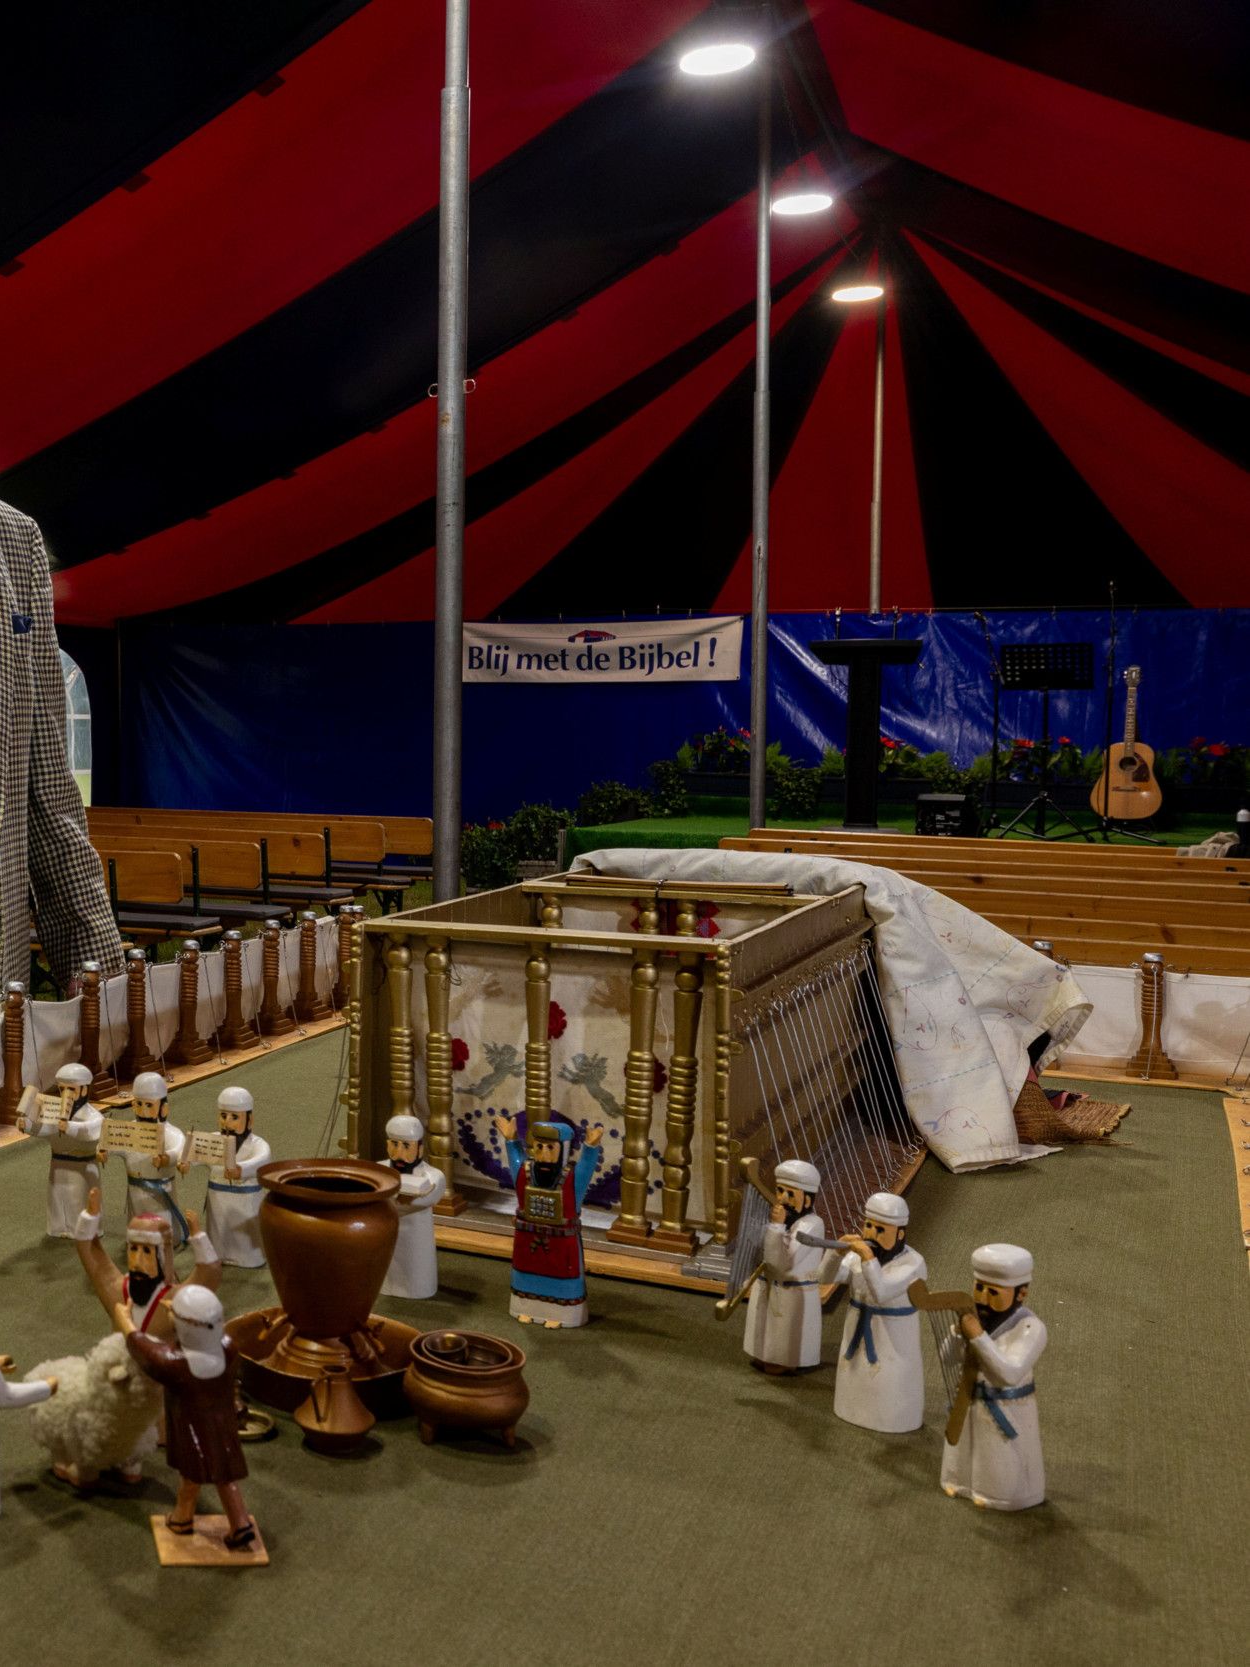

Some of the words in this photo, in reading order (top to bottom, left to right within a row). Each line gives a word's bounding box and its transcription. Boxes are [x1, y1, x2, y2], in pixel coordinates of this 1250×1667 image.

[468, 645, 509, 676] Blij
[516, 648, 569, 671] met
[576, 645, 611, 671] de
